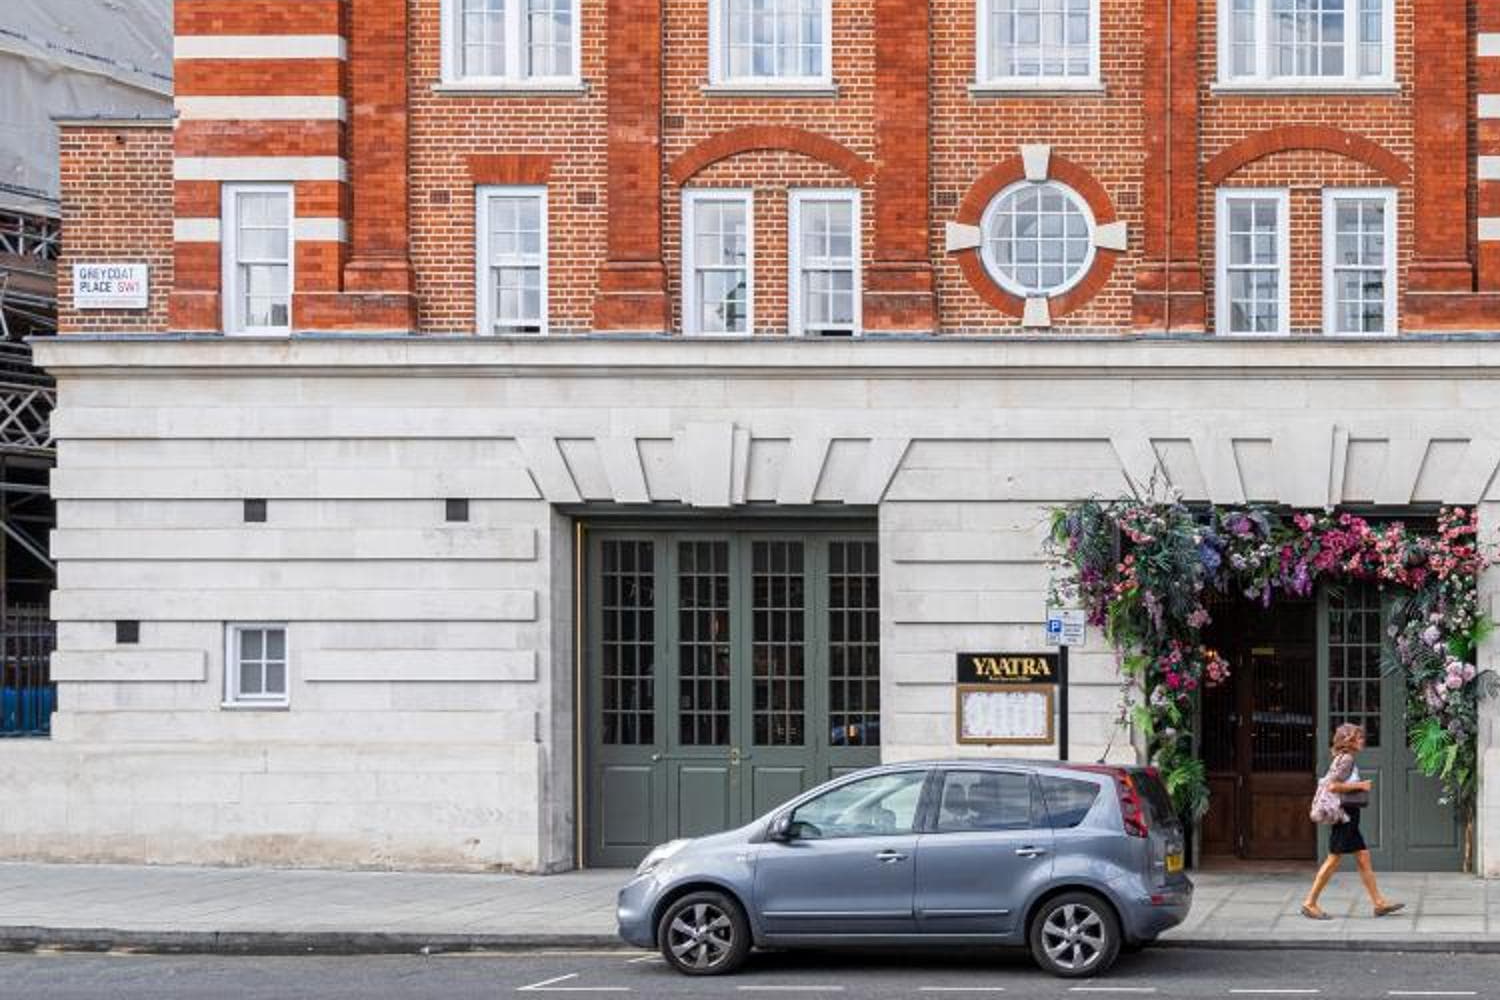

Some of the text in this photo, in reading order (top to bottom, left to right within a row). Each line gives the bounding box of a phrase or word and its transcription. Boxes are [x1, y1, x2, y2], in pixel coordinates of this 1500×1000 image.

[80, 268, 133, 279] GREYCOAT
[80, 281, 112, 292] PLACE
[973, 657, 1051, 675] YAATRA
